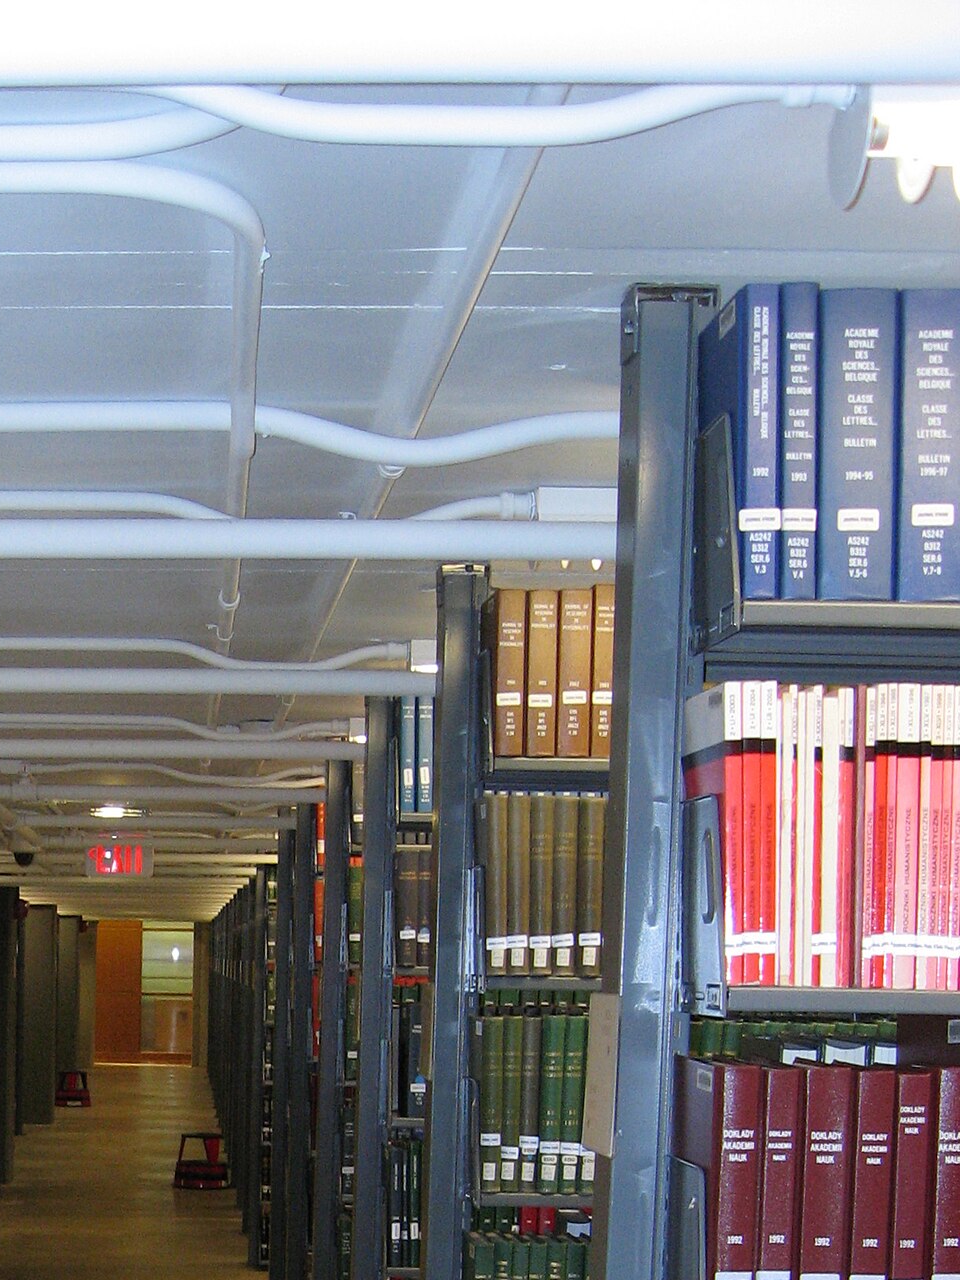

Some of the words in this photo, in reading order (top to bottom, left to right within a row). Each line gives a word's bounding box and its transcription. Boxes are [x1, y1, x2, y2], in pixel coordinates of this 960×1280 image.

[787, 332, 814, 340] ACADEMIE
[845, 329, 879, 337] ACADEMIE
[919, 330, 953, 339] ACADEMIE
[848, 340, 874, 349] ROYALE
[923, 343, 949, 351] ROYALE
[855, 351, 868, 359] DES
[929, 355, 942, 364] DES
[845, 373, 877, 382] BELGIQUE
[919, 380, 951, 390] BELGIQUE
[787, 387, 812, 395] BELGIQUE
[848, 395, 873, 403] CLASSE
[854, 406, 868, 414] DES
[922, 405, 947, 413] CLASSE
[928, 418, 941, 426] DES
[844, 438, 876, 447] BULLETIN
[918, 455, 950, 464] BULLETIN
[753, 468, 769, 476] 1992
[846, 471, 873, 480] 1994-95
[921, 467, 948, 476] 1996-97
[792, 472, 807, 481] 1993
[750, 533, 771, 542] AS242
[922, 530, 944, 538] AS242
[788, 538, 809, 547] AS242
[848, 537, 869, 545] AS242
[752, 544, 768, 553] B312
[924, 542, 940, 550] B312
[790, 549, 806, 557] B312
[850, 548, 866, 556] B312
[755, 566, 766, 574] V.3
[923, 567, 941, 575] V.7-8
[793, 571, 803, 579] V.4
[724, 1130, 754, 1138] DOKLADY
[905, 1127, 919, 1135] NAUK
[811, 1132, 842, 1140] DOKLADY
[723, 1142, 754, 1150] AKADEMII
[811, 1143, 842, 1152] AKADEMII
[729, 1154, 747, 1162] NAUK
[816, 1155, 834, 1164] NAUK
[867, 1157, 881, 1165] NAUK
[727, 1236, 742, 1244] 1992
[769, 1235, 784, 1243] 1992
[815, 1238, 830, 1246] 1992
[862, 1239, 878, 1247] 1992
[943, 1239, 958, 1247] 1992
[899, 1240, 915, 1248] 1992
